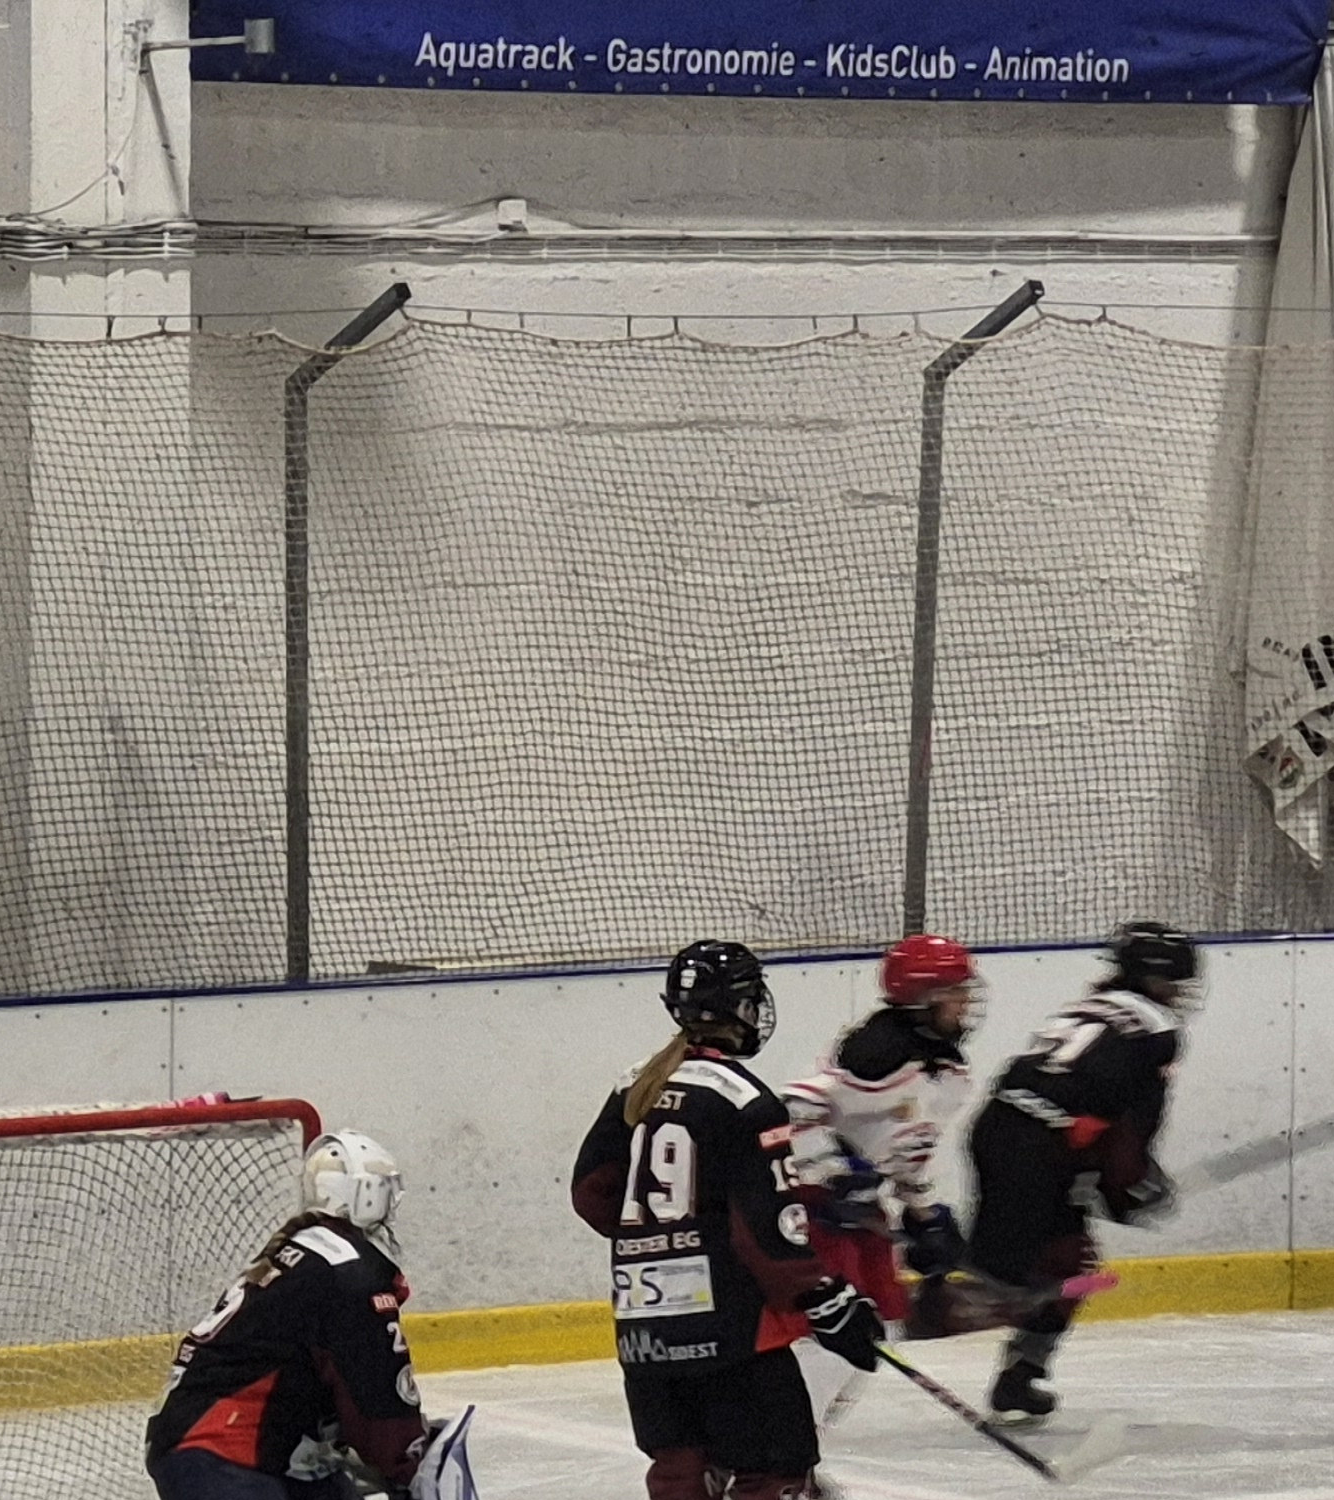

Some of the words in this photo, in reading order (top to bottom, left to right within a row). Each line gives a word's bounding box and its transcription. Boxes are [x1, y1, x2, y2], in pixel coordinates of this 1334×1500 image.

[415, 31, 576, 77] Aquatrack
[606, 38, 796, 77] Gastronomie
[826, 43, 957, 80] KidsClub
[983, 46, 1130, 83] Animation
[619, 1121, 698, 1226] 19
[672, 1229, 702, 1250] EG
